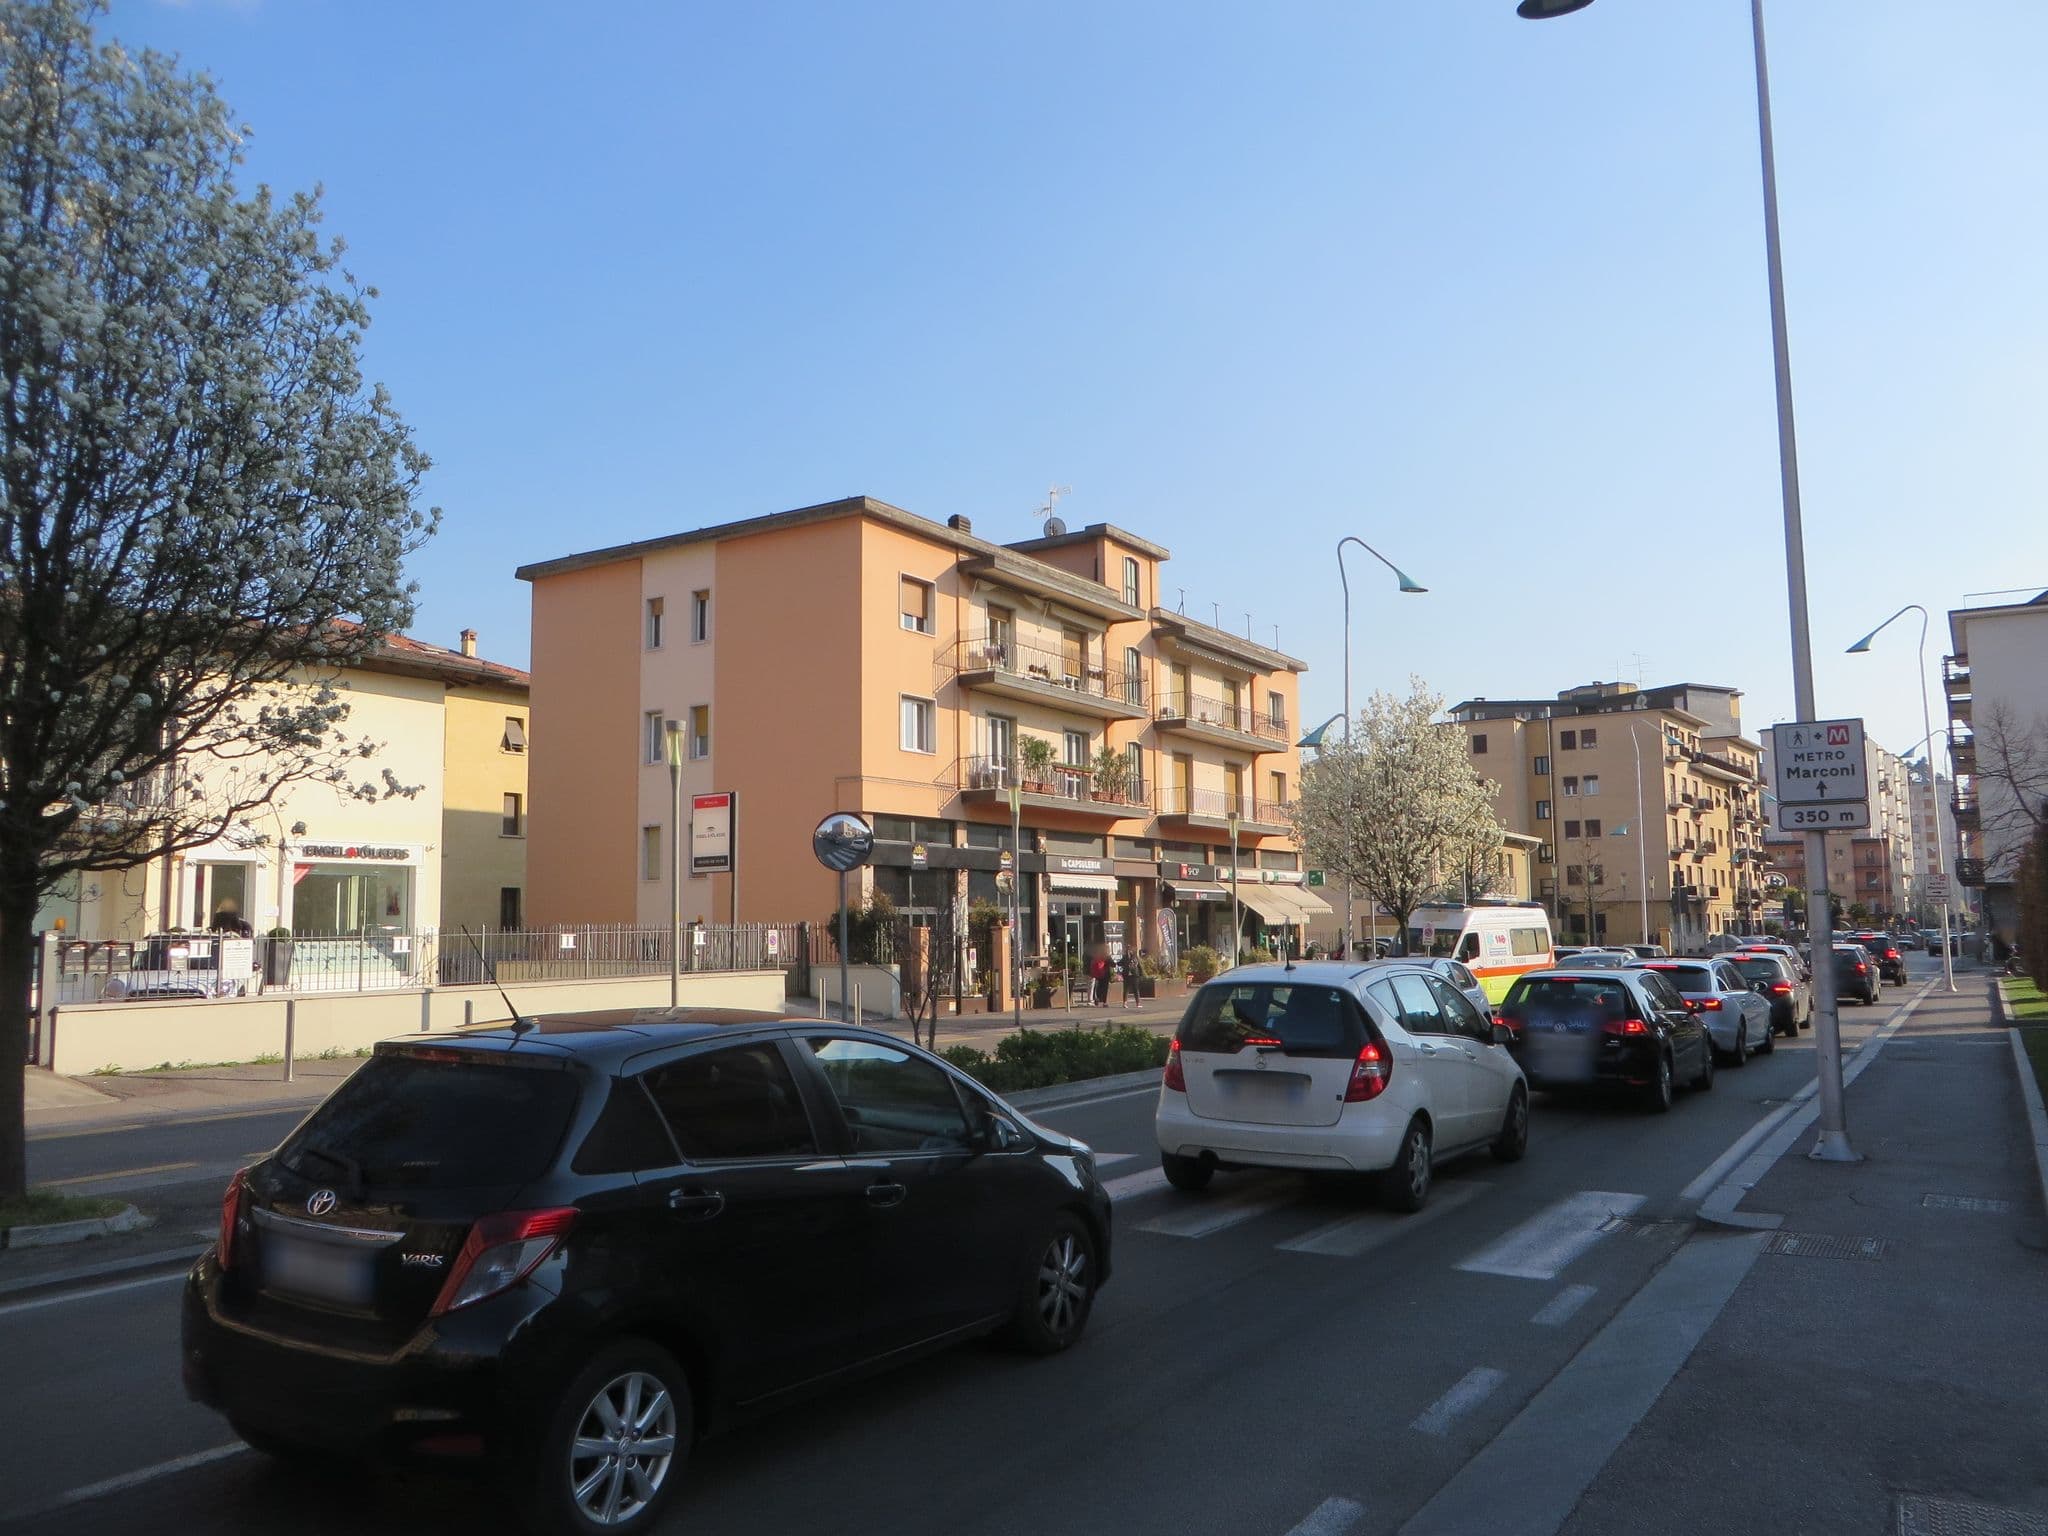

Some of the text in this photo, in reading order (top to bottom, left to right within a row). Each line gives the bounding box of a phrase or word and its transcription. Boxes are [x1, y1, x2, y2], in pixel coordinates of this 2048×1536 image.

[1828, 728, 1849, 743] M
[1794, 750, 1845, 762] METRO
[1786, 763, 1856, 779] Marconi
[1793, 810, 1854, 823] 350 m
